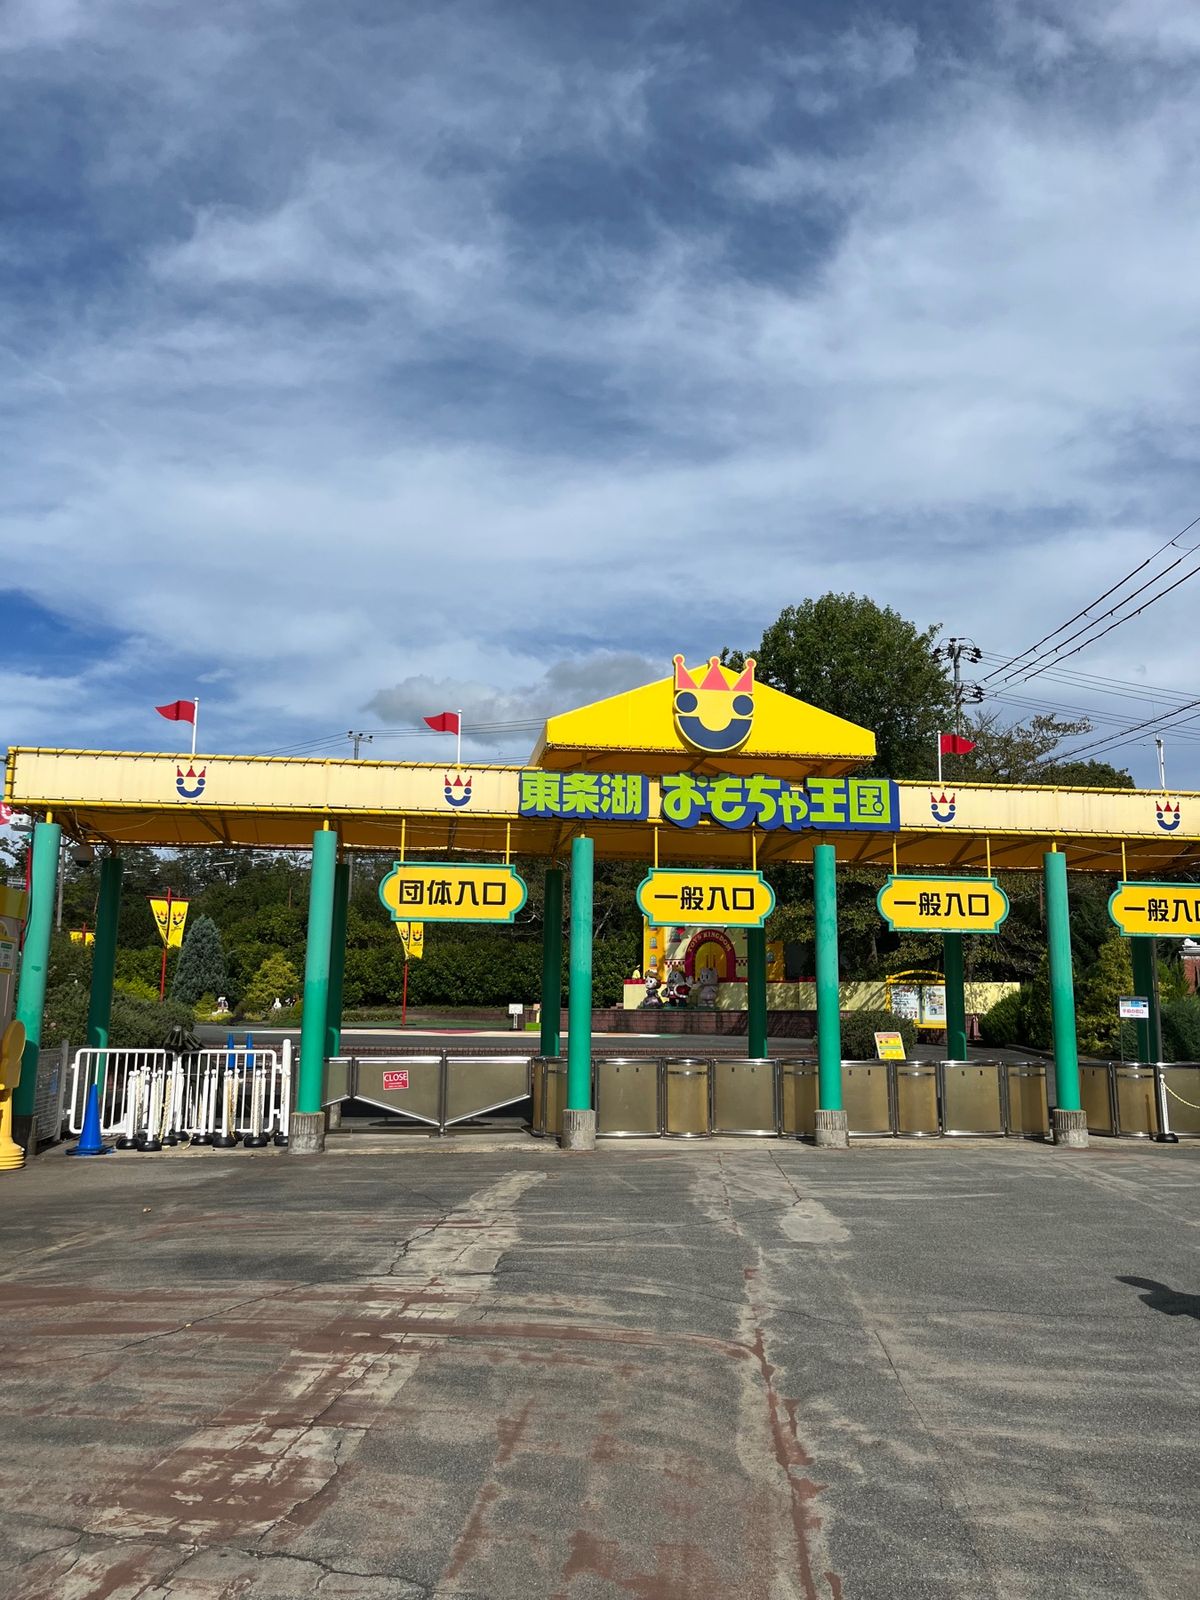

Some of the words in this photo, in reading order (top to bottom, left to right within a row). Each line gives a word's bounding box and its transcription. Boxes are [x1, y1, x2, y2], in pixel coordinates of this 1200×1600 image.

[520, 772, 643, 815] 東条湖
[662, 772, 891, 824] おもちゃ王国
[399, 880, 506, 905] 団体入口
[654, 886, 754, 911] 一般入口
[894, 892, 989, 916] 一般入口
[1124, 898, 1200, 922] 一般入
[384, 1072, 408, 1081] CLOSE
